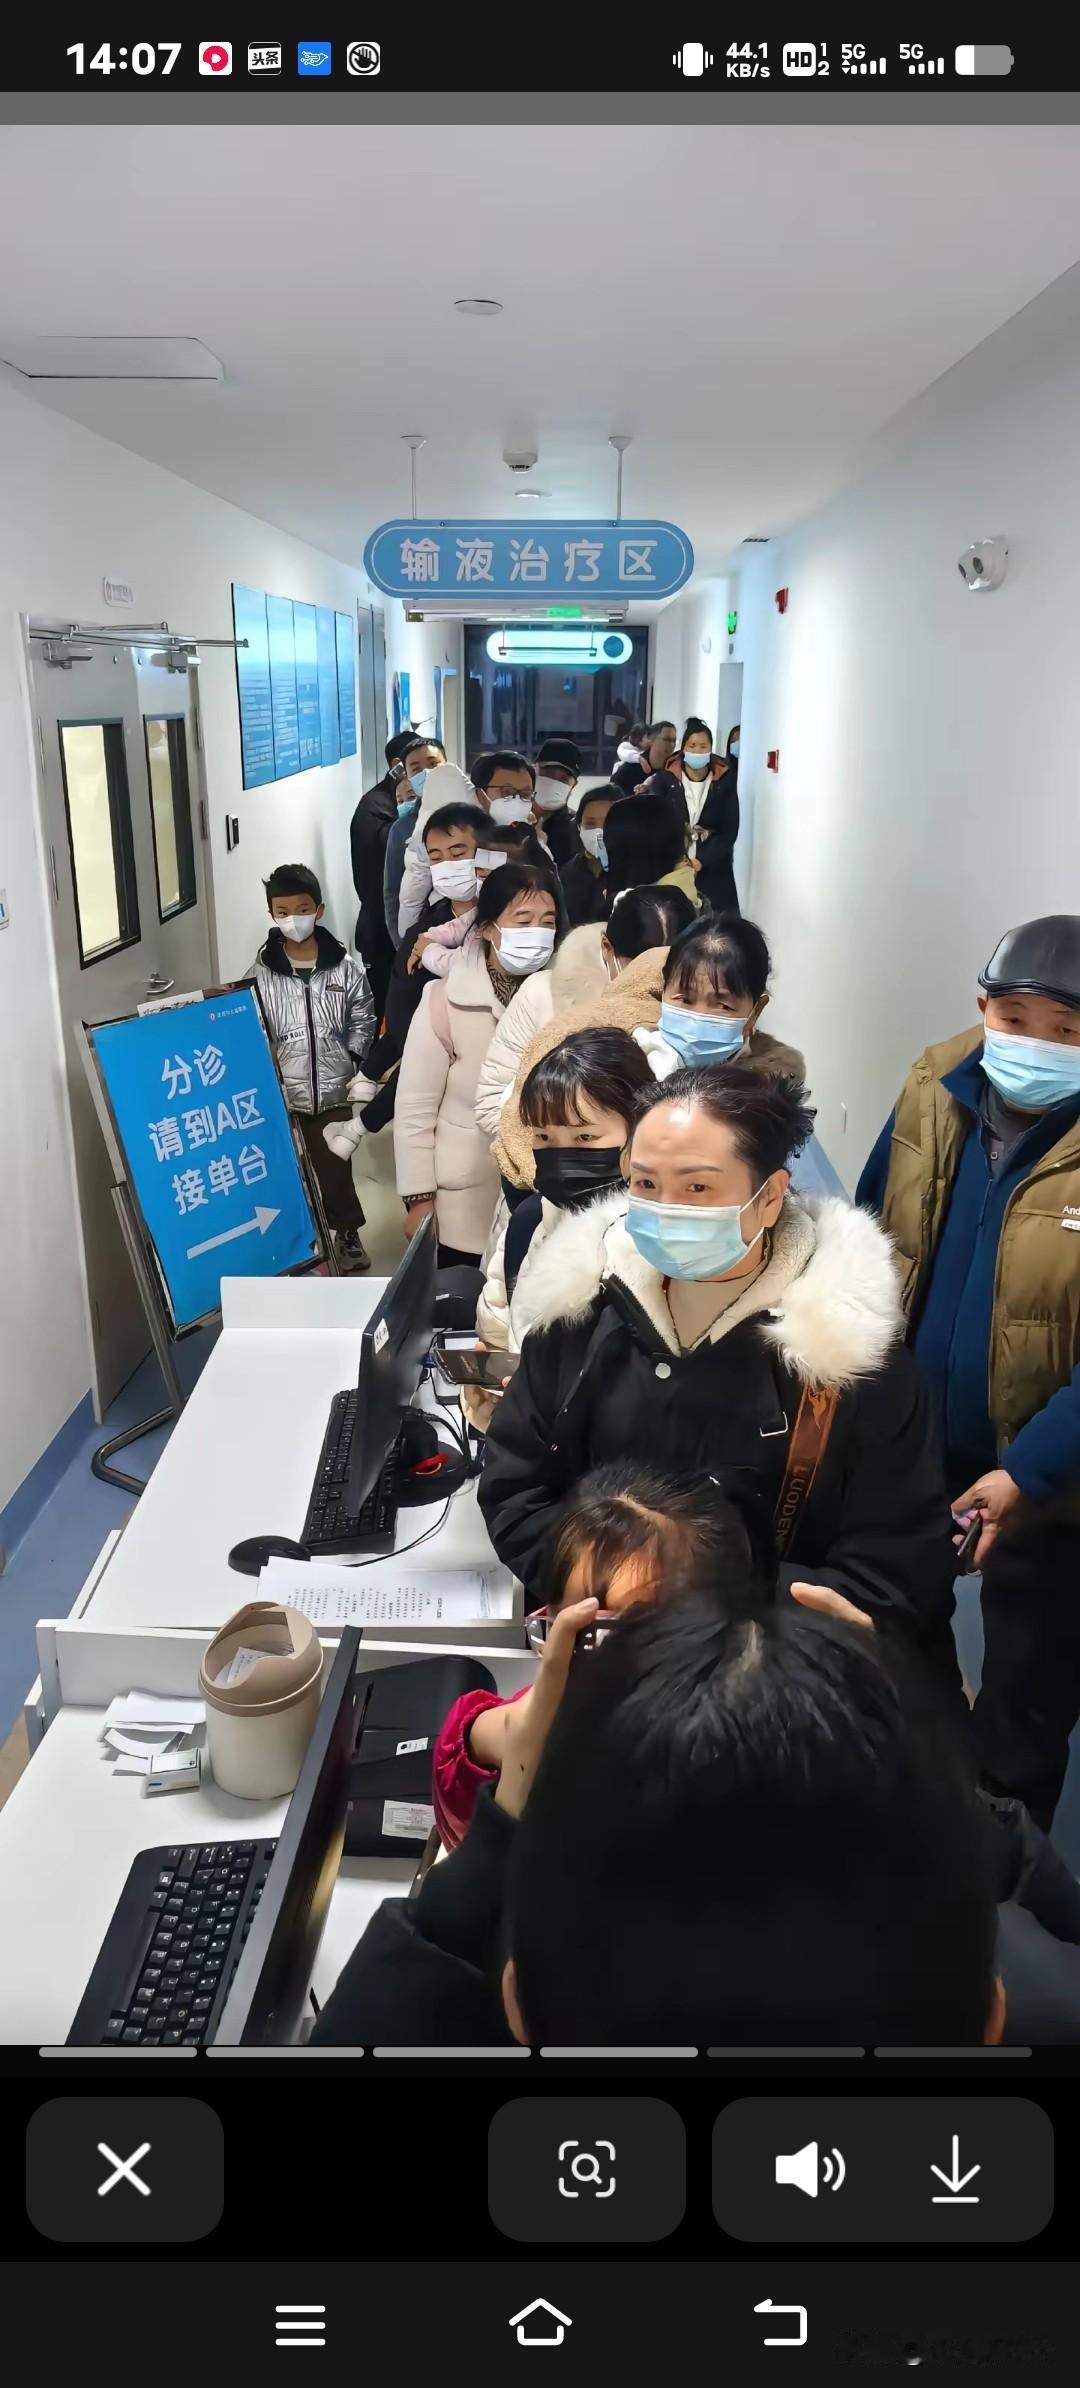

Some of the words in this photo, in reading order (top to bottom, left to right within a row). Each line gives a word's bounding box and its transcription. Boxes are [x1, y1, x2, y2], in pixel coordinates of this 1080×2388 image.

[399, 537, 659, 583] 输液治疗区
[160, 1044, 226, 1100] 分诊
[148, 1087, 266, 1163] 请到A区
[170, 1143, 269, 1216] 接单台
